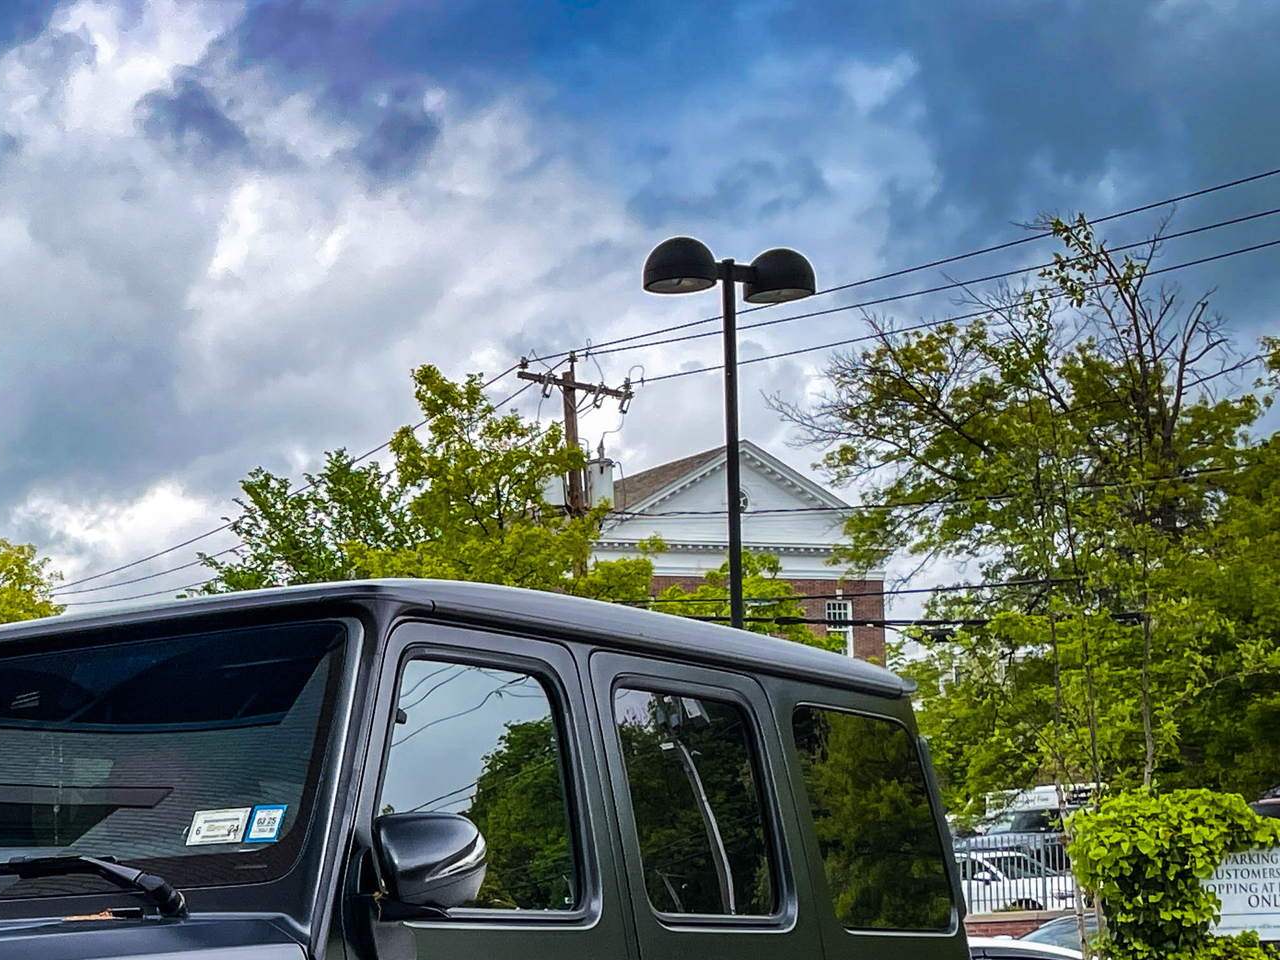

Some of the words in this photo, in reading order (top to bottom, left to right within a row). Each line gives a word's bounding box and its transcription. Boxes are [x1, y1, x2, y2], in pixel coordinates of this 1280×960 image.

[1225, 853, 1279, 865] PARKING
[1261, 883, 1275, 893] AT
[1248, 895, 1280, 908] ONL
